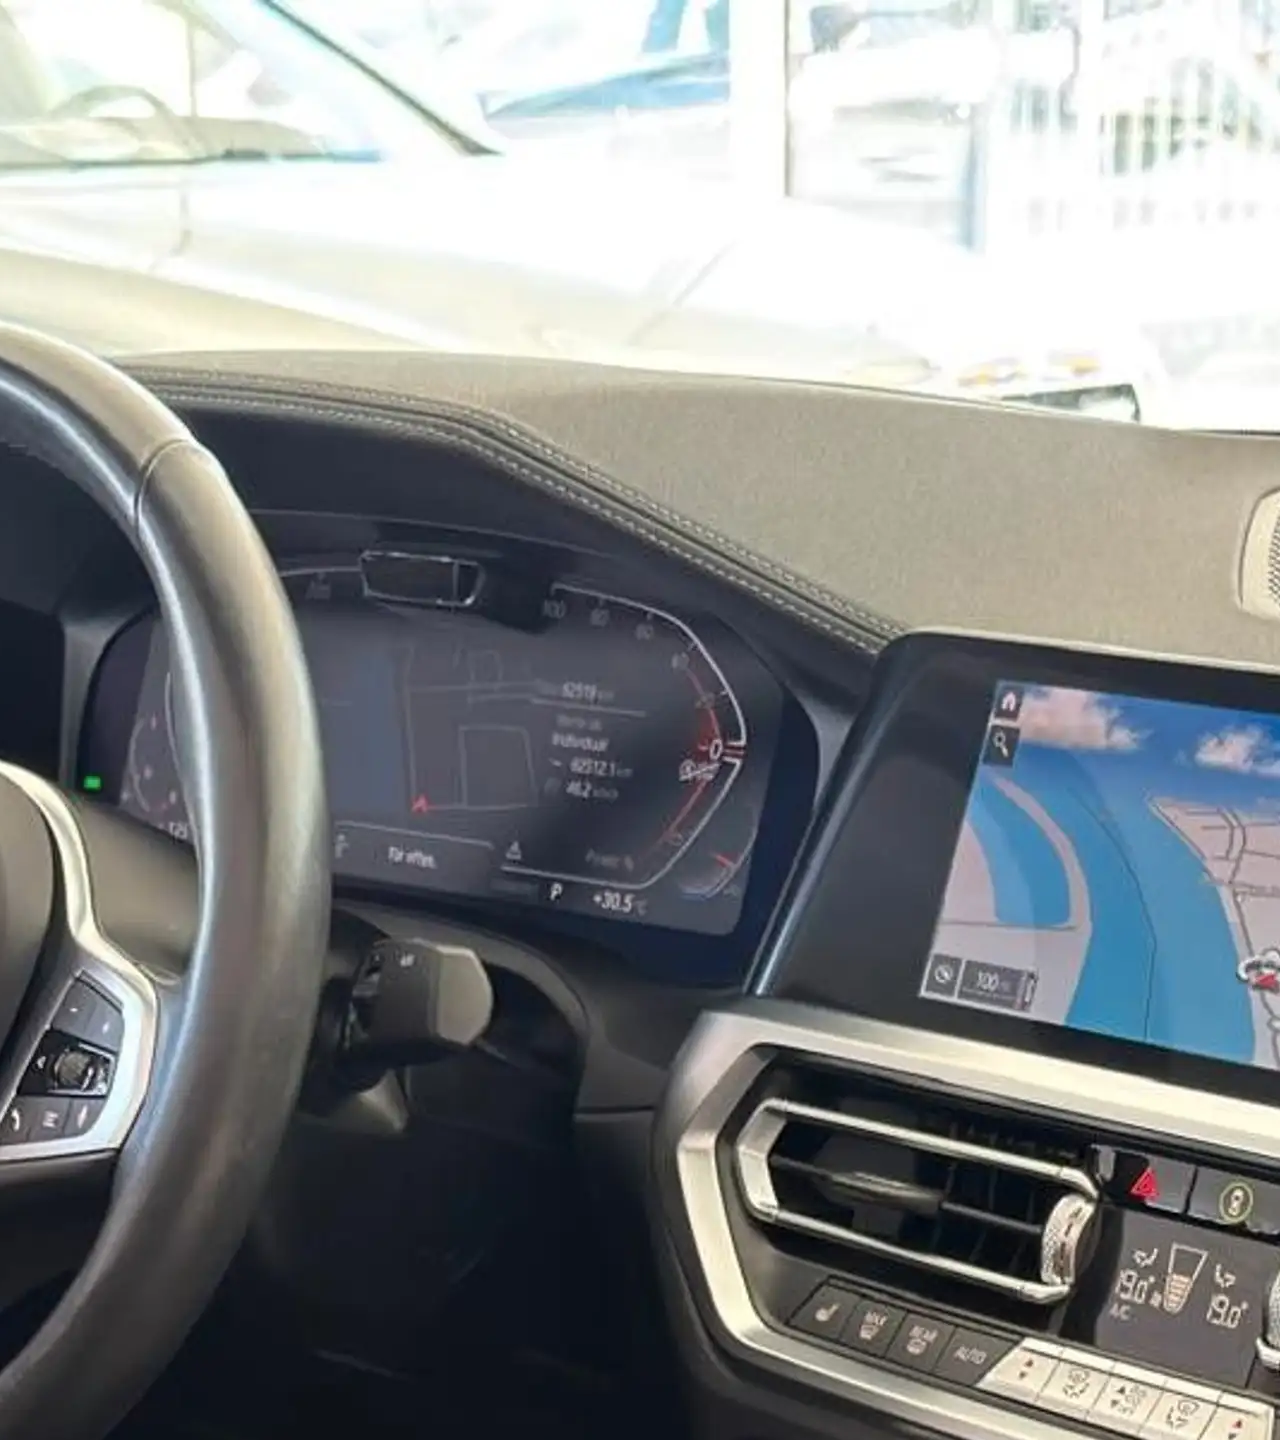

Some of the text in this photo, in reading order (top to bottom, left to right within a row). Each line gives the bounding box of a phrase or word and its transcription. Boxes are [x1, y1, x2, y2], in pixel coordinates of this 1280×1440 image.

[709, 738, 723, 760] 0
[549, 883, 563, 901] P
[592, 891, 635, 914] +30.5
